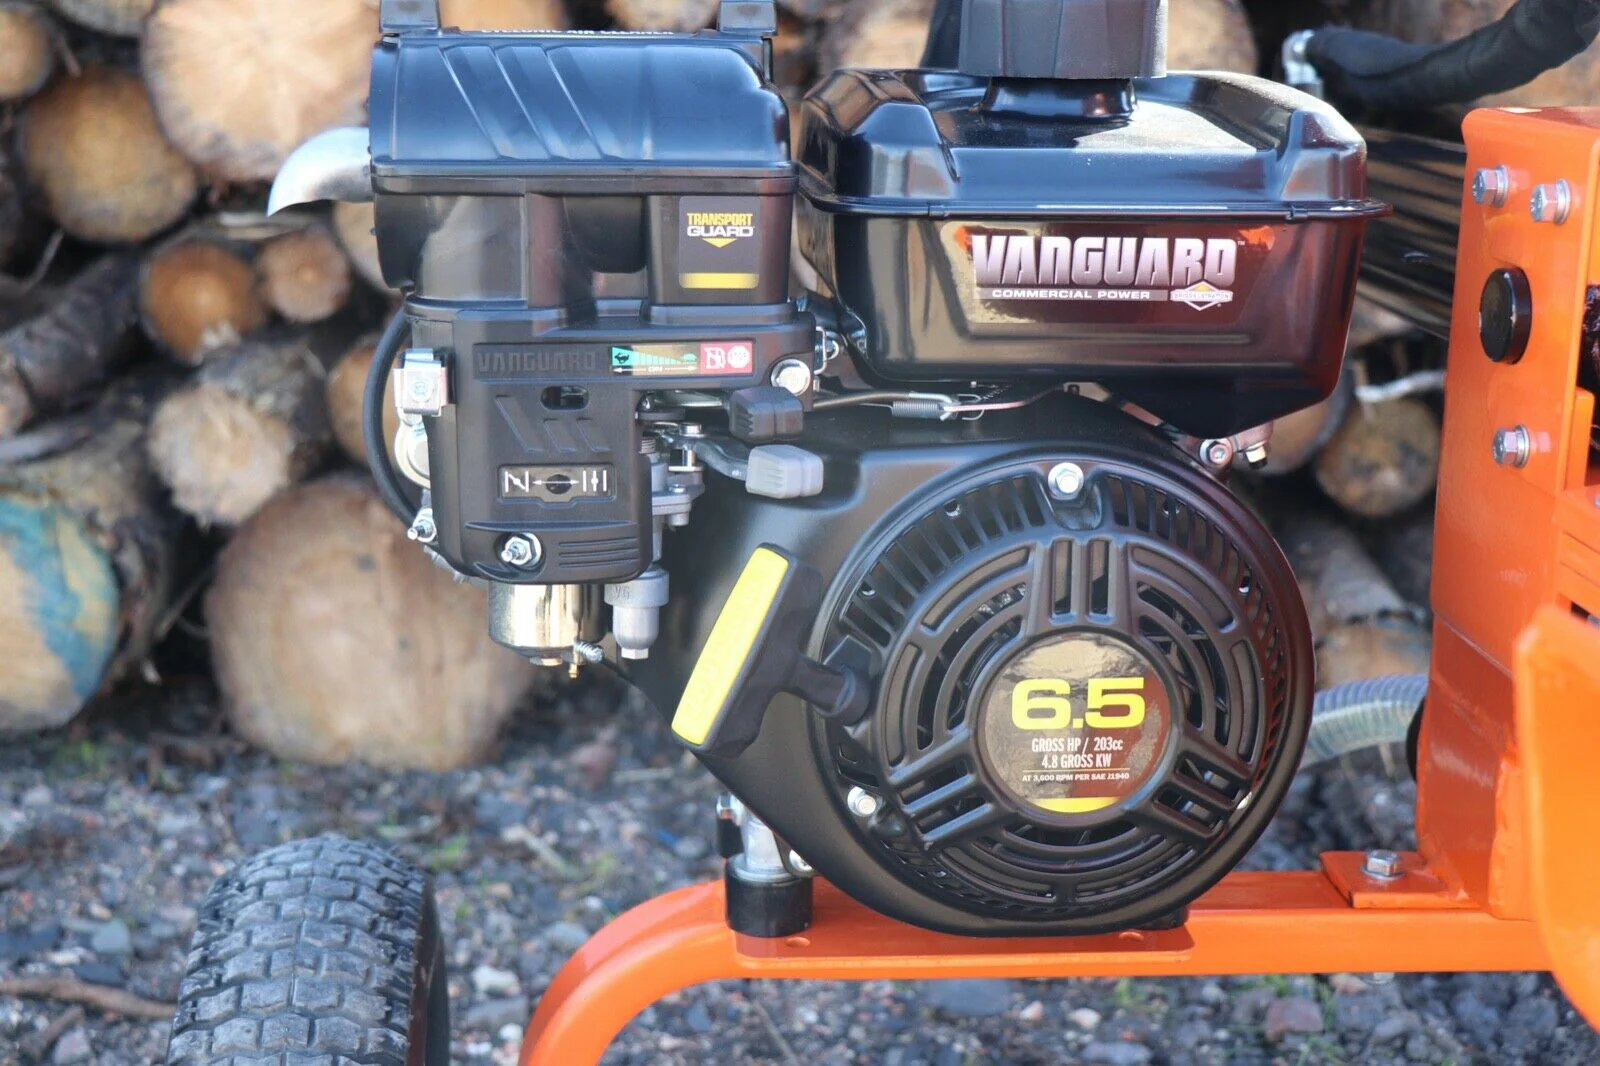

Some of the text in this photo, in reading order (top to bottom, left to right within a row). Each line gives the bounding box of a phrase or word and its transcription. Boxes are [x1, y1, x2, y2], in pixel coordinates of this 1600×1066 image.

[687, 212, 754, 226] TRANSPORT
[687, 225, 754, 237] GUARD
[972, 235, 1237, 286] VANGUARD
[992, 289, 1150, 300] COMMERCIAL POWER
[478, 352, 597, 372] VANGUARD
[1011, 677, 1146, 730] 6.5
[1031, 737, 1065, 752] GROSS
[1093, 736, 1124, 751] 203cc
[1041, 753, 1112, 769] 4.8 GROSS KW
